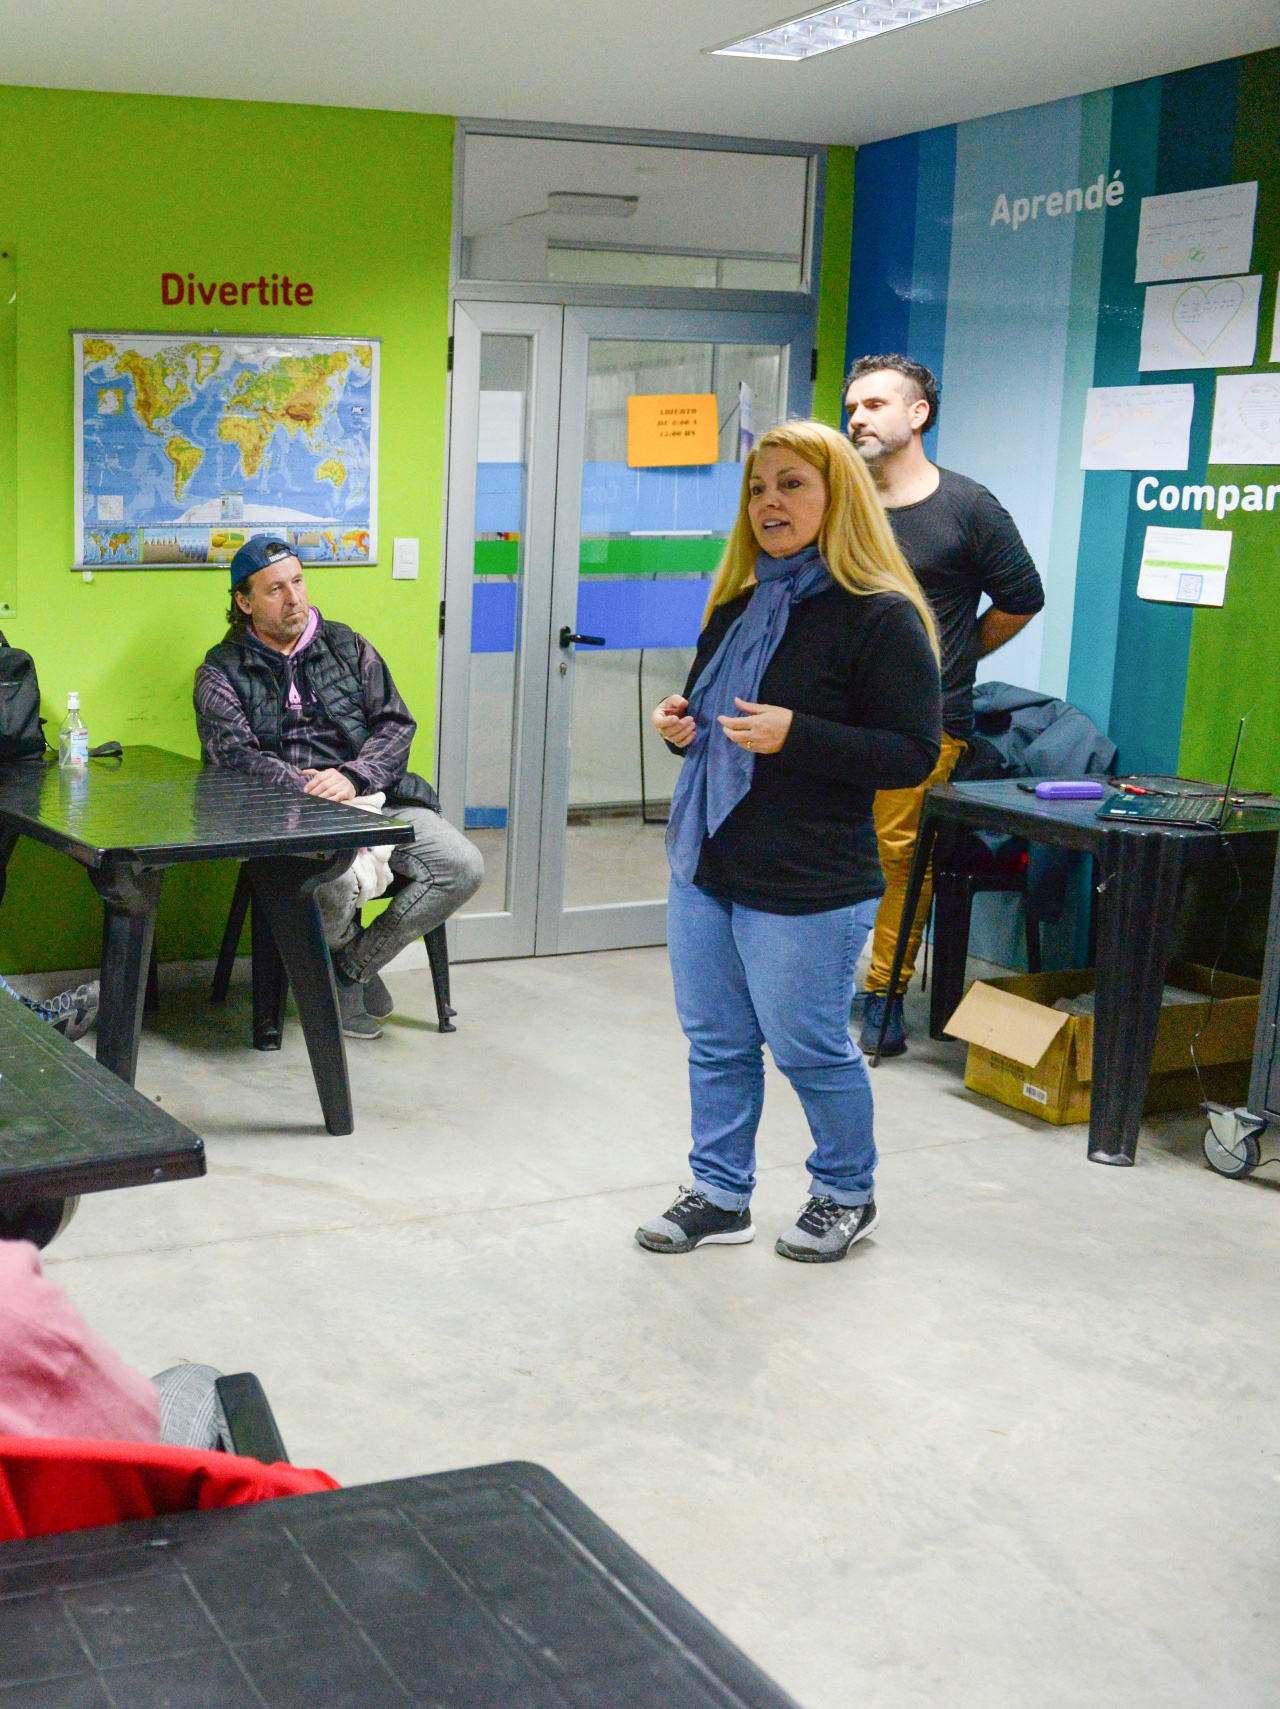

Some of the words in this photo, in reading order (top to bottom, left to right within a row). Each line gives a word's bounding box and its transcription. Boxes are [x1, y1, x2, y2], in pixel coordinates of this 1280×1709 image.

[989, 169, 1125, 231] Aprendé
[161, 272, 314, 306] Divertite
[1136, 476, 1280, 520] Compar
